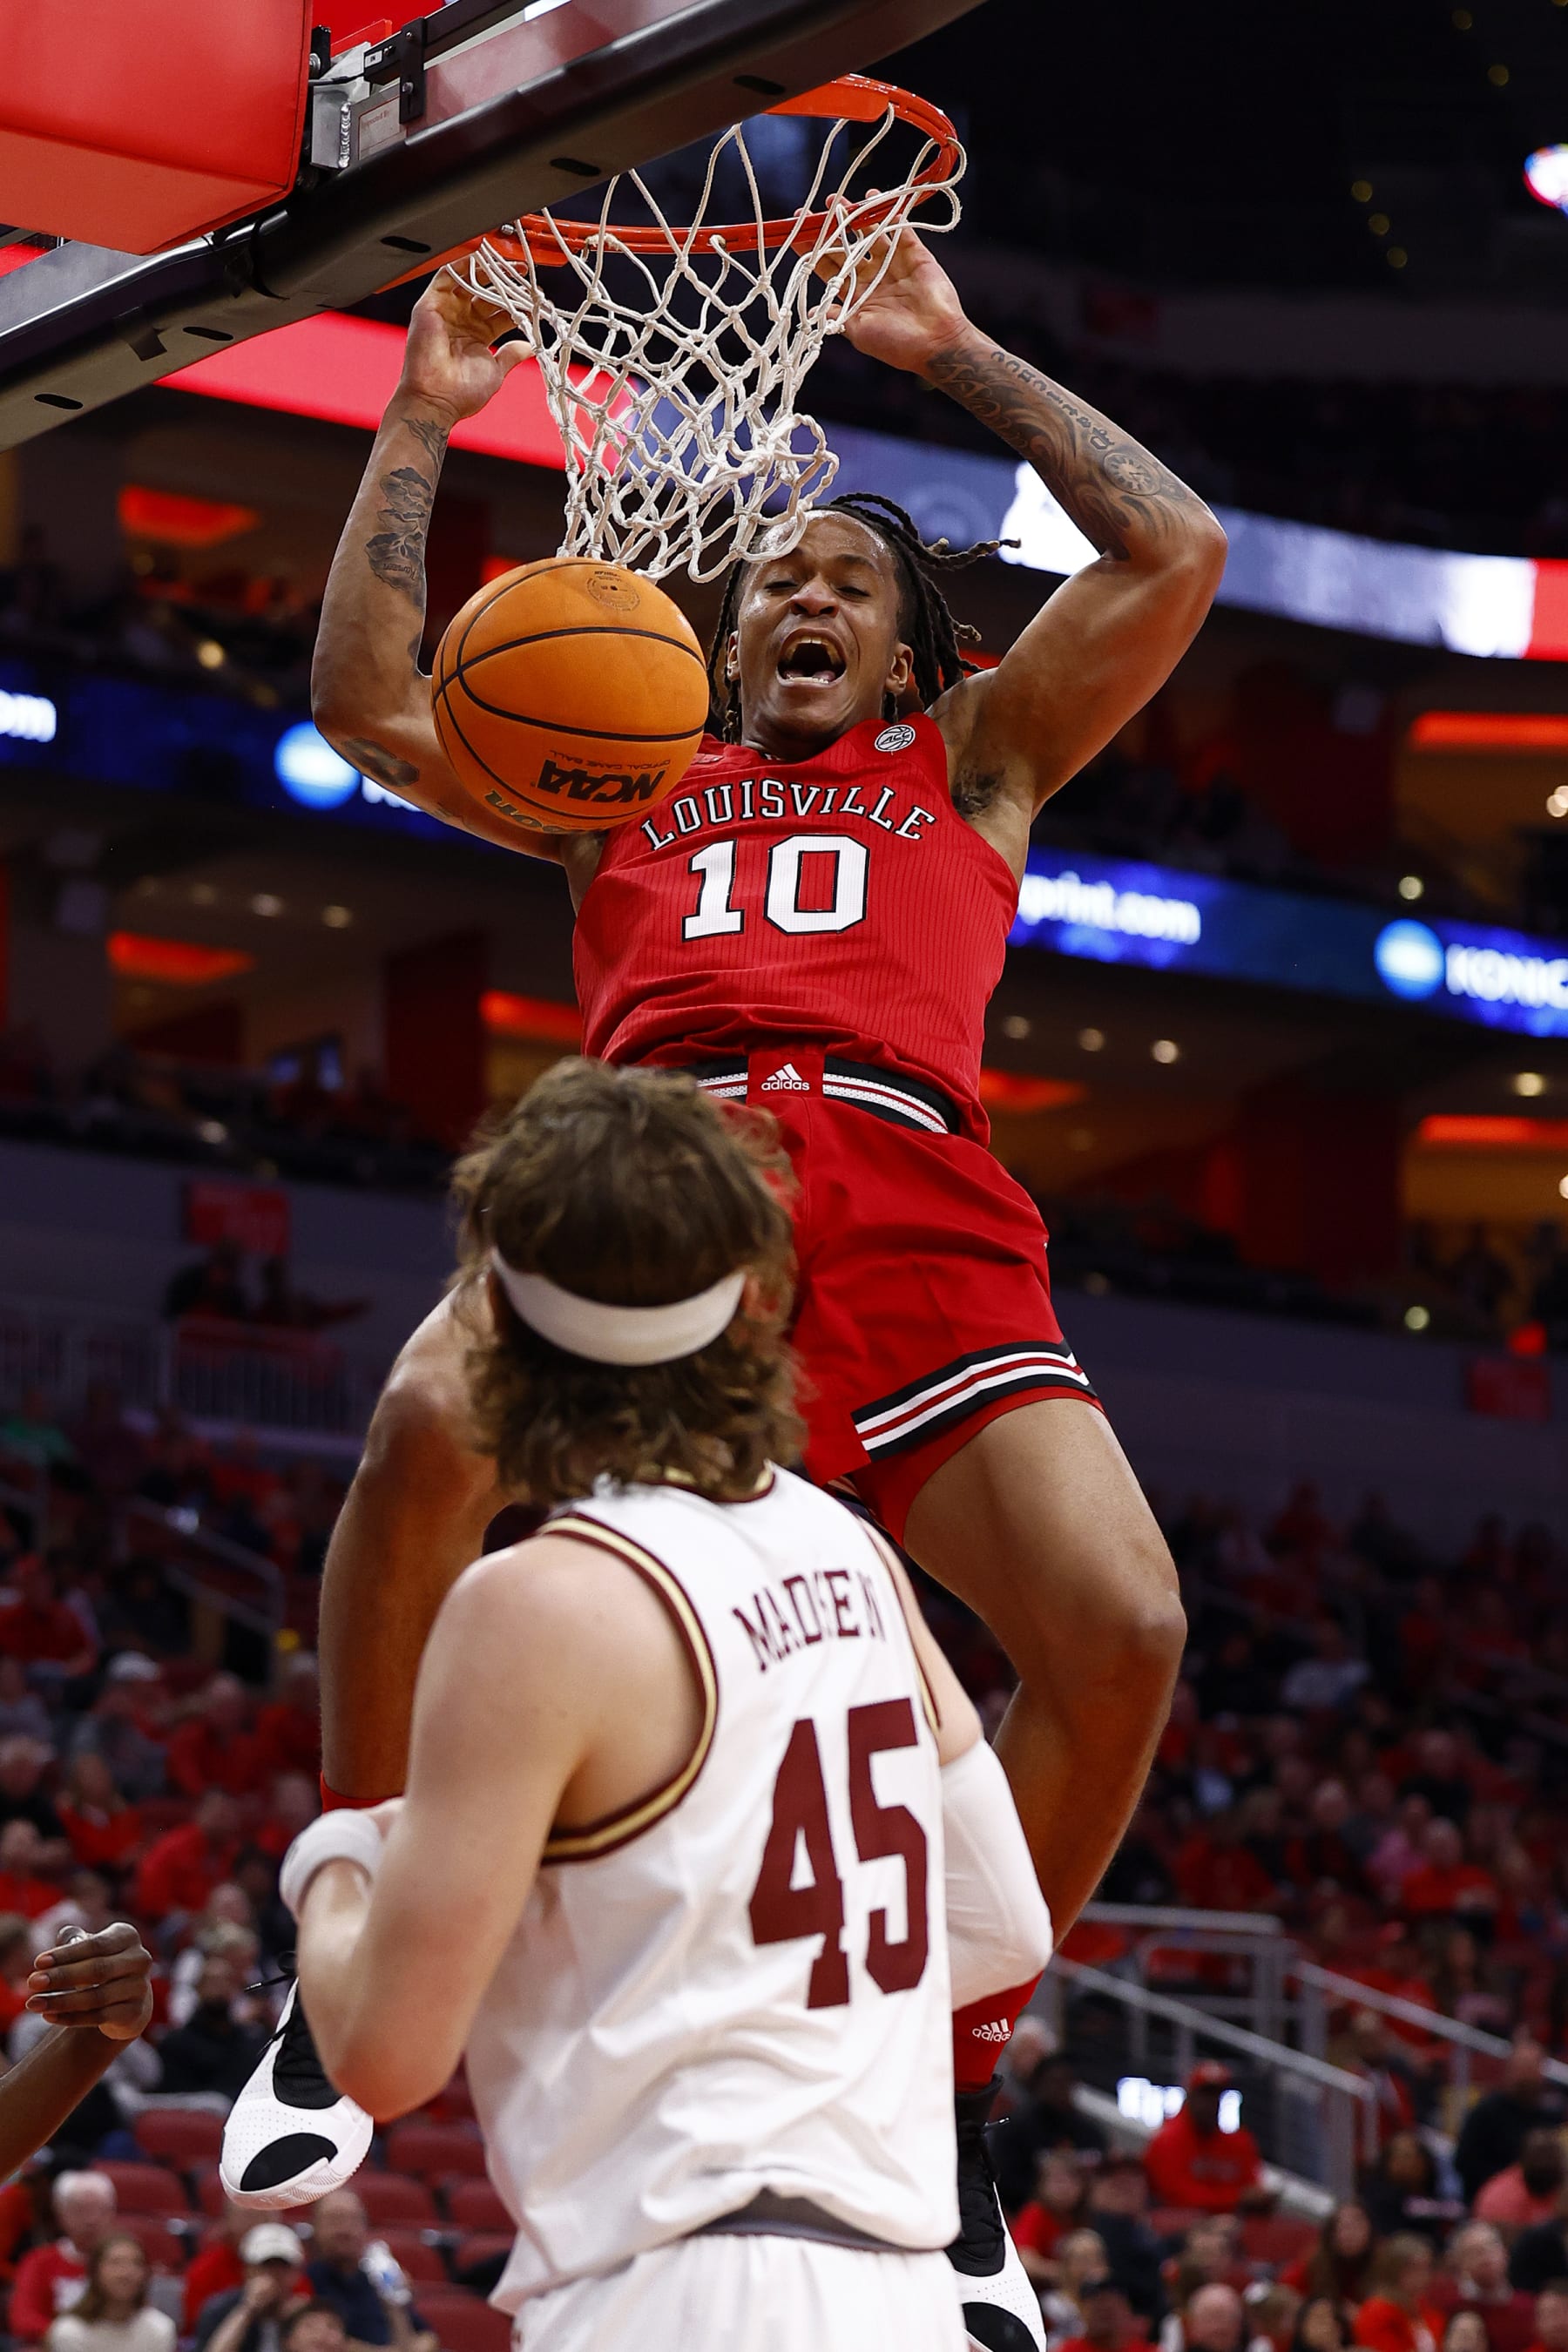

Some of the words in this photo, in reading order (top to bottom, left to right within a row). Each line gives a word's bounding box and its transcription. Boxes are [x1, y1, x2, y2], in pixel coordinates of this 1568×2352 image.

[550, 750, 585, 763] BALL
[880, 728, 910, 746] ACC
[537, 759, 666, 803] NCAA
[641, 778, 936, 851] LOUISVILLE
[682, 834, 870, 942] 10
[760, 1078, 810, 1092] adidas
[749, 1698, 928, 2010] 45
